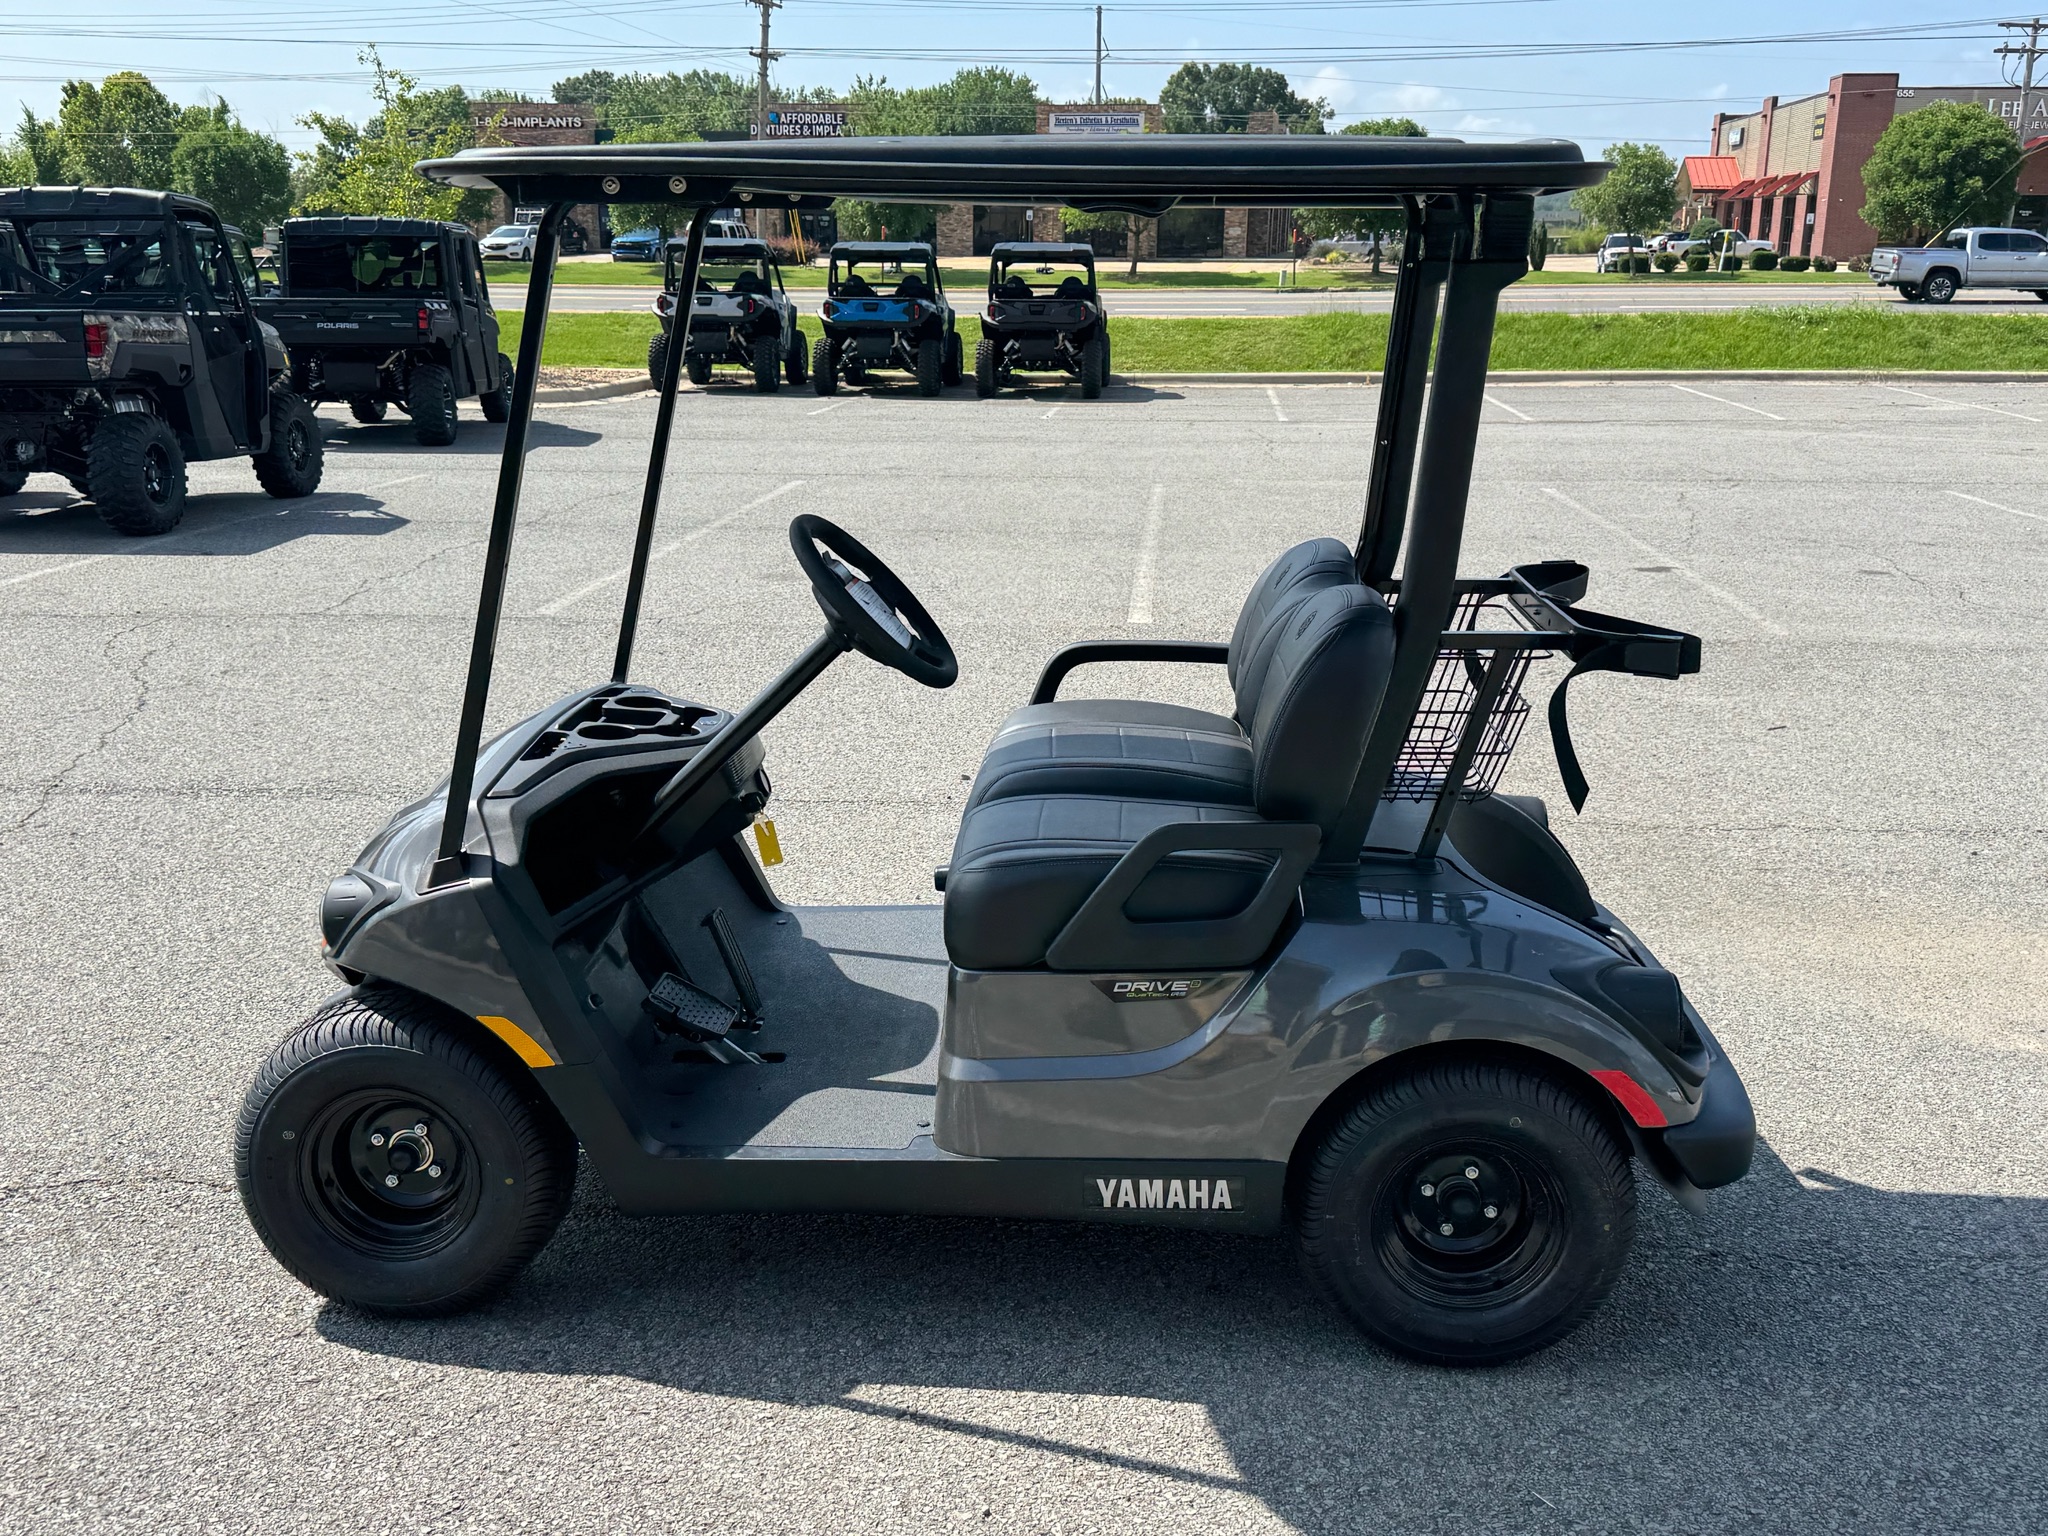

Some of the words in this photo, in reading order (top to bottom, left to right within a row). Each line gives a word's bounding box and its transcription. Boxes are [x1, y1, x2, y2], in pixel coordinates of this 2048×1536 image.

[1897, 90, 1915, 98] 655
[780, 113, 843, 125] AFFORDABLE
[750, 124, 801, 136] DNTURES
[802, 124, 811, 136] &
[132, 329, 175, 338] RANGER
[1096, 1178, 1233, 1209] YAMAHA
